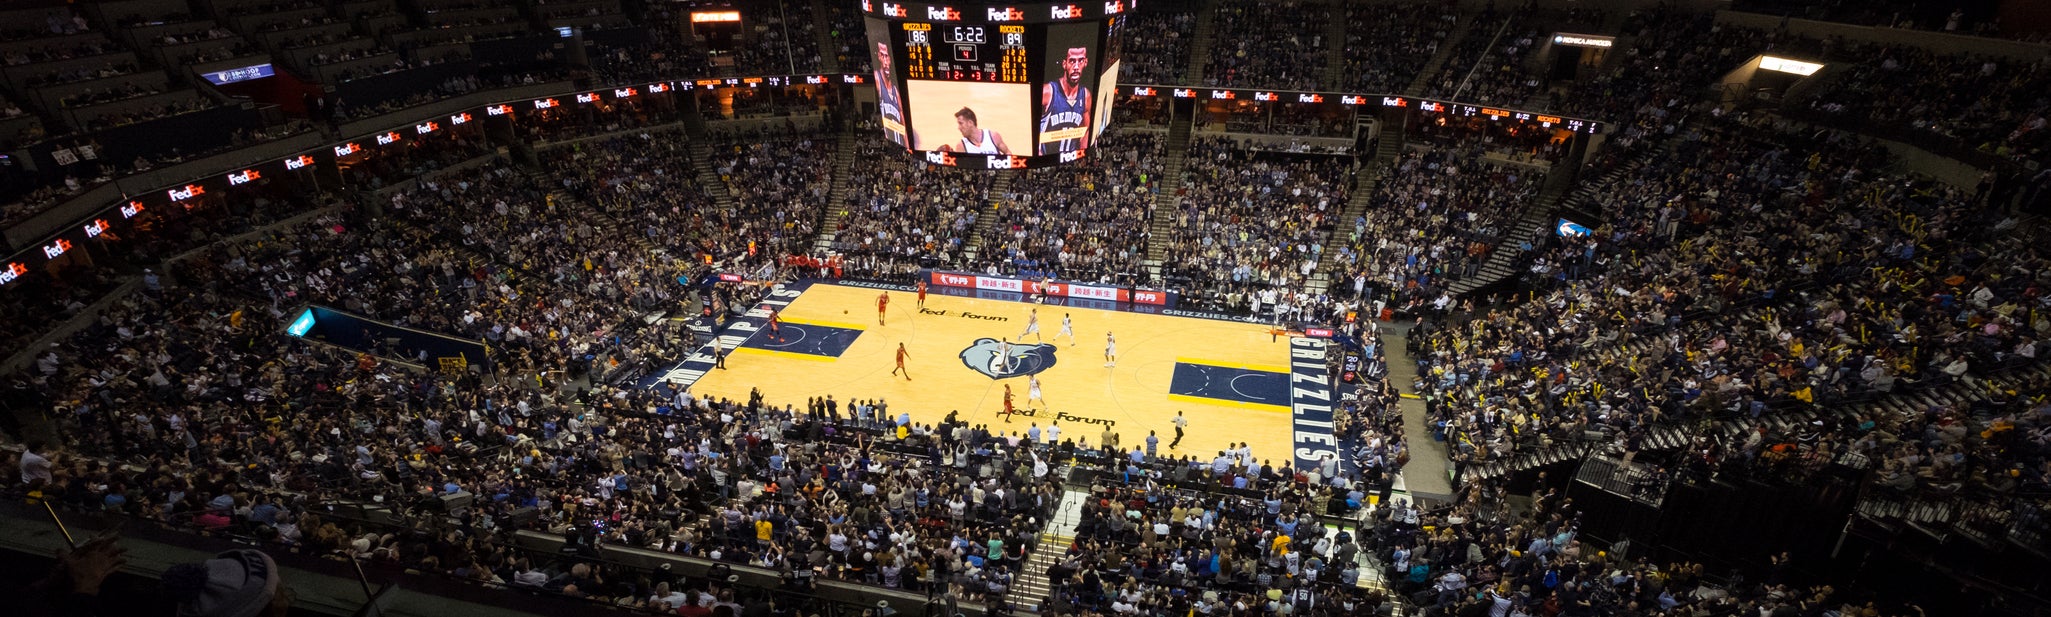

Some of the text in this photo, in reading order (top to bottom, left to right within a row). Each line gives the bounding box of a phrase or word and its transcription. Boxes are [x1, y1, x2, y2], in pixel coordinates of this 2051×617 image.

[884, 3, 907, 17] FedEx
[928, 6, 960, 20] FedEx
[1052, 6, 1082, 20] FedEx
[1105, 1, 1124, 14] FedEx
[988, 8, 1024, 21] FedEx
[903, 23, 931, 31] GRIZZLIES
[1000, 25, 1024, 34] ROCKETS
[913, 30, 926, 42] 86
[954, 26, 983, 42] 6:22
[1008, 33, 1020, 44] 89
[807, 75, 828, 84] FedEx
[844, 74, 864, 84] FedEx
[616, 87, 637, 98] FedEx
[1134, 87, 1156, 96] FedEx
[1174, 88, 1196, 98] FedEx
[1212, 90, 1235, 99] FedEx
[1255, 92, 1278, 101] FedEx
[534, 98, 560, 109] FedEx
[577, 92, 600, 104] FedEx
[1300, 94, 1323, 103] FedEx
[1342, 96, 1366, 104] FedEx
[1383, 97, 1407, 108] FedEx
[487, 104, 513, 116] FedEx
[1421, 101, 1444, 113] FedEx
[452, 112, 472, 125] FedEx
[416, 122, 439, 134] FedEx
[377, 132, 401, 145] FedEx
[334, 142, 361, 157] FedEx
[926, 151, 957, 166] FedEx
[1060, 149, 1086, 163] FedEx
[285, 155, 315, 170] FedEx
[987, 156, 1027, 169] FedEx
[228, 170, 261, 186] FedEx
[168, 184, 206, 201] FedEx
[120, 201, 146, 218] FedEx
[84, 219, 110, 238] FedEx
[43, 239, 73, 259] FedEx
[1291, 338, 1337, 462] GRIZZLIES
[1300, 592, 1308, 600] 50
